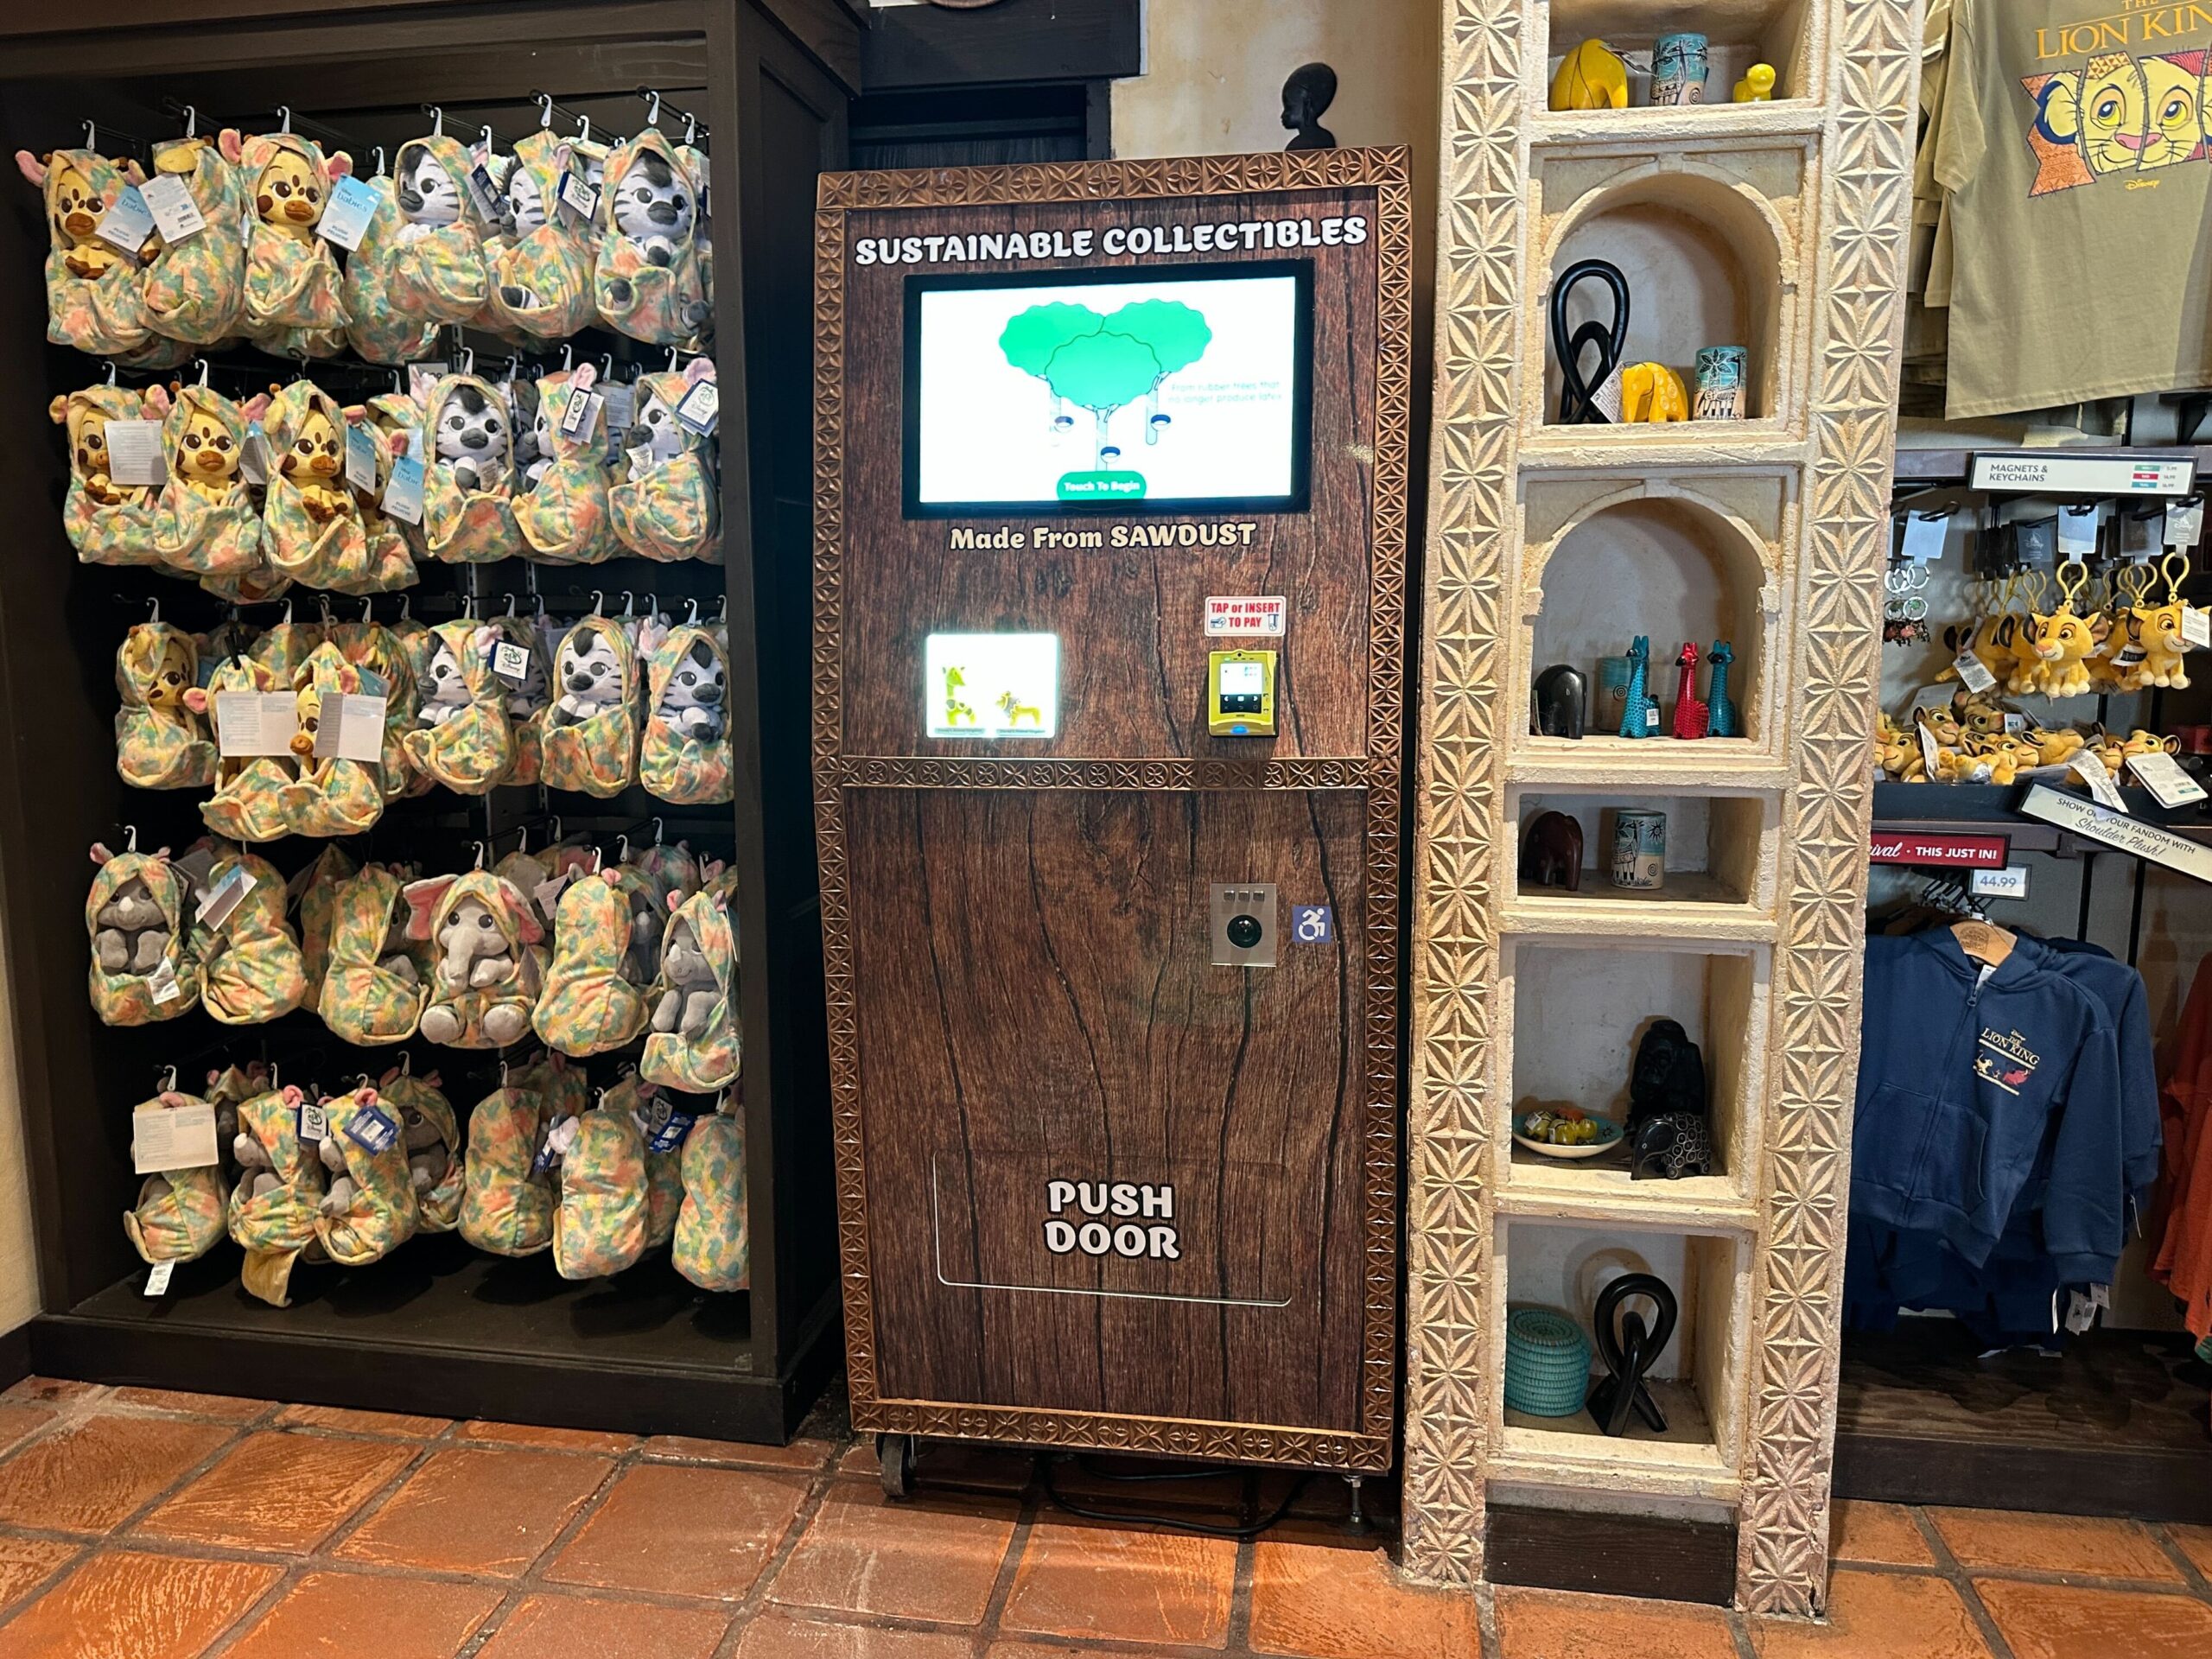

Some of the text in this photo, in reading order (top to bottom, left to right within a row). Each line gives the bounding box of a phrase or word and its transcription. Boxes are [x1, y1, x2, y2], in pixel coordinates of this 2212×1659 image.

[2035, 4, 2212, 60] LION KIN
[2123, 178, 2159, 190] Disney
[336, 191, 367, 213] babies
[855, 216, 1368, 265] SUSTAINABLE COLLECTIBLES
[1216, 392, 1257, 403] produce
[1989, 473, 2045, 482] KEYCHAINS
[1990, 464, 2049, 474] MAGNETS &
[1064, 480, 1141, 493] Touch To Begin
[950, 523, 1257, 550] Made From SAWDUST
[1211, 602, 1281, 613] TAP or INSERT
[1229, 617, 1262, 628] TO PAY
[2056, 798, 2086, 812] SHOW
[2131, 825, 2171, 845] FANDOM
[2171, 840, 2196, 855] WITH
[2075, 817, 2167, 857] Shoulder Plush!
[1870, 842, 1997, 860] ival THIS JUST IN!
[1980, 875, 2017, 888] 44.99
[1980, 1027, 2040, 1065] LION KING
[1047, 1180, 1173, 1218] PUSH
[1044, 1219, 1180, 1260] DOOR
